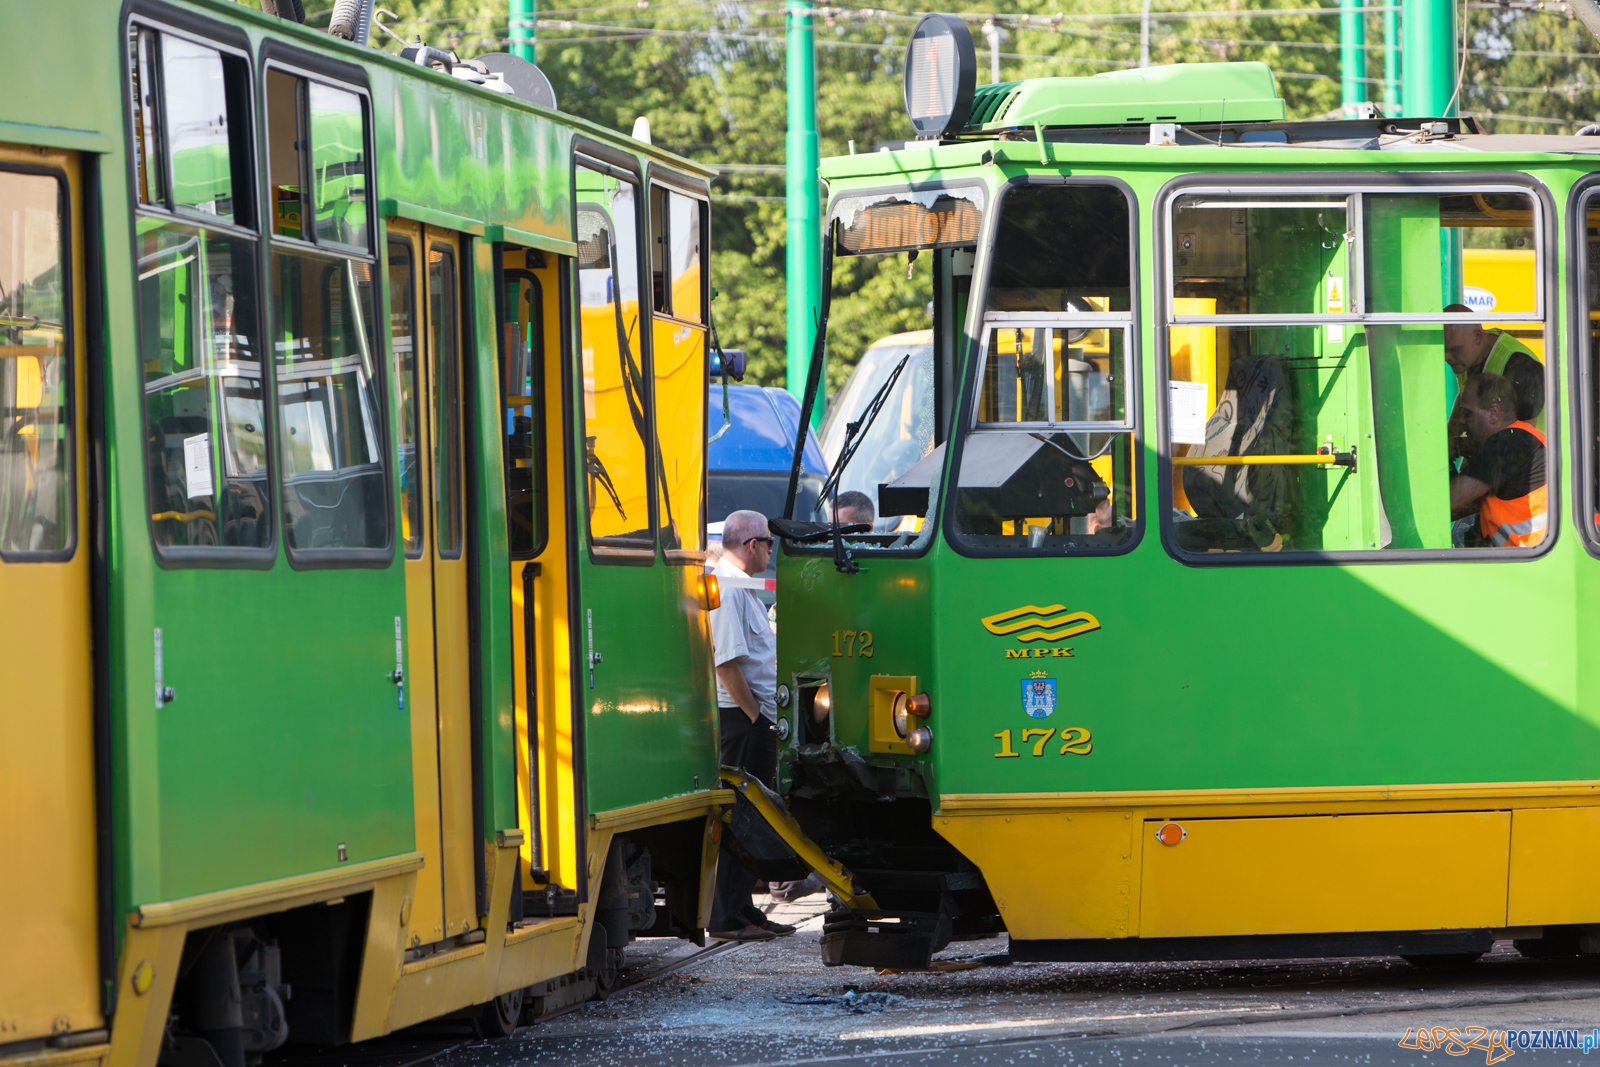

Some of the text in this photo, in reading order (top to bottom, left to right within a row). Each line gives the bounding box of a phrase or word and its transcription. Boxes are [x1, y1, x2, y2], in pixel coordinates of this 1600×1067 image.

[924, 35, 940, 117] 1
[859, 203, 977, 250] Junikowo
[831, 629, 875, 659] 172
[1004, 647, 1075, 660] MPK
[993, 726, 1094, 759] 172
